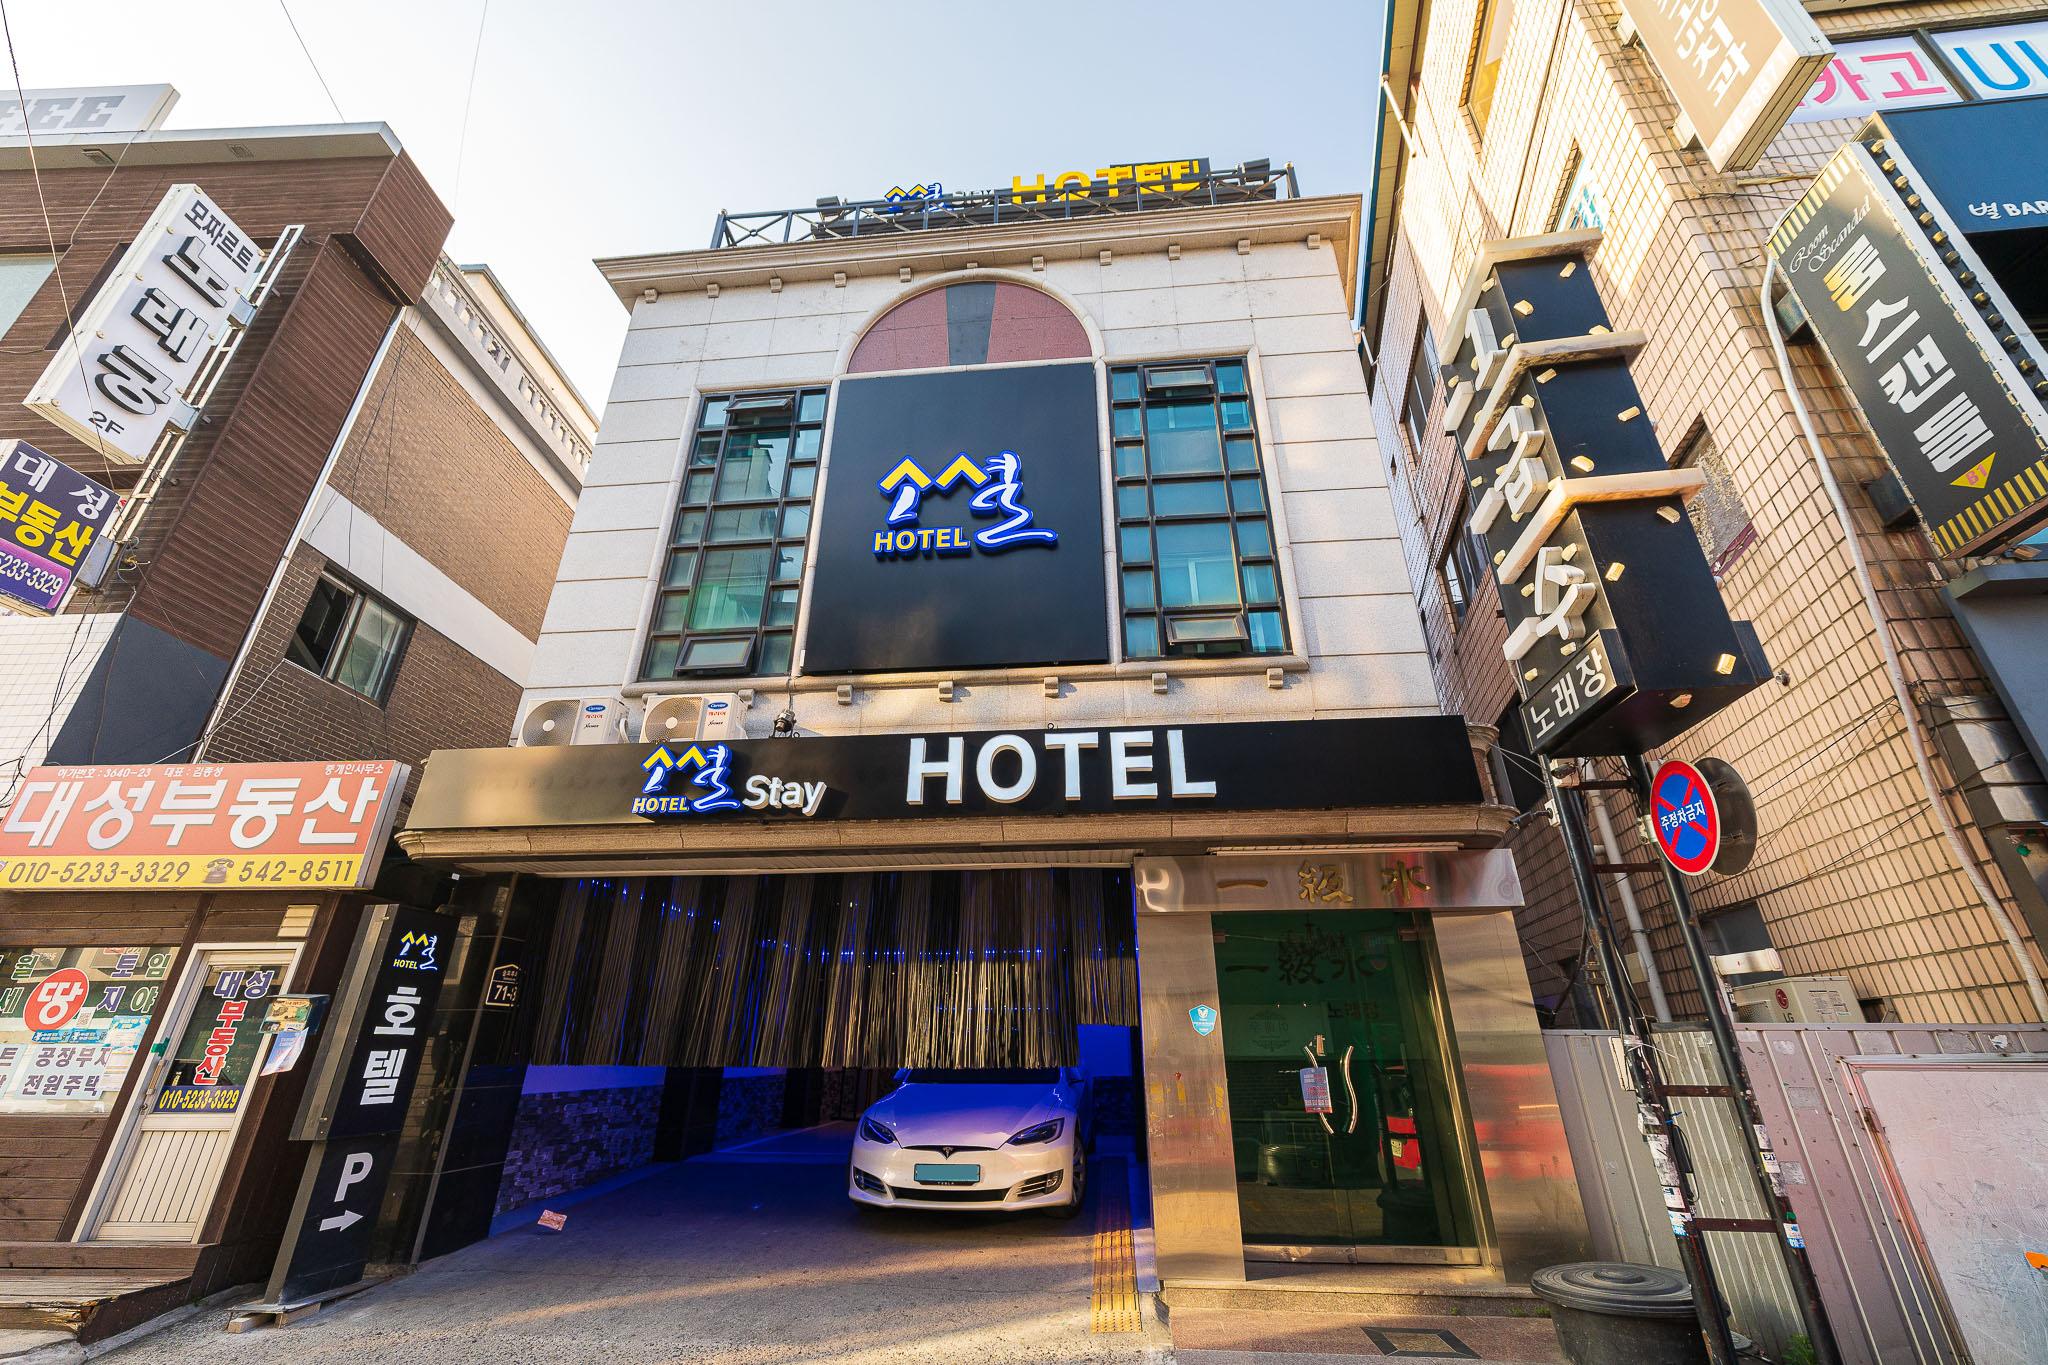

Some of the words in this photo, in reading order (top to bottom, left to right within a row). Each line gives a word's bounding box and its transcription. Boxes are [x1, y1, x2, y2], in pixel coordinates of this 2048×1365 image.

[1794, 51, 1947, 107] 카고
[1808, 194, 1872, 273] Scandal
[1968, 202, 2002, 220] 별
[184, 199, 254, 274] 모짜르트
[1789, 225, 1829, 273] Room
[95, 235, 230, 416] 노래궁
[88, 410, 125, 436] 2F
[14, 451, 111, 520] 대성
[1966, 463, 1989, 487] B1
[0, 481, 95, 567] 부동산
[873, 526, 971, 558] HOTEL
[1529, 647, 1608, 740] 노래장
[324, 763, 385, 776] 중개인사무소
[907, 729, 1217, 805] HOTEL
[3, 776, 381, 850] 대성부동산
[631, 795, 691, 814] HOTEL
[742, 774, 827, 817] Stay
[1660, 799, 1707, 832] 주정차금지
[8, 861, 191, 884] 010-5233-3329
[237, 860, 355, 883] 542-8511
[213, 970, 275, 1000] 대성
[393, 957, 418, 970] HOTEL
[37, 981, 85, 1026] 땅
[1783, 1012, 1795, 1023] LG
[193, 1000, 248, 1086] 부동산
[359, 986, 422, 1106] 호텔
[334, 1152, 374, 1203] P
